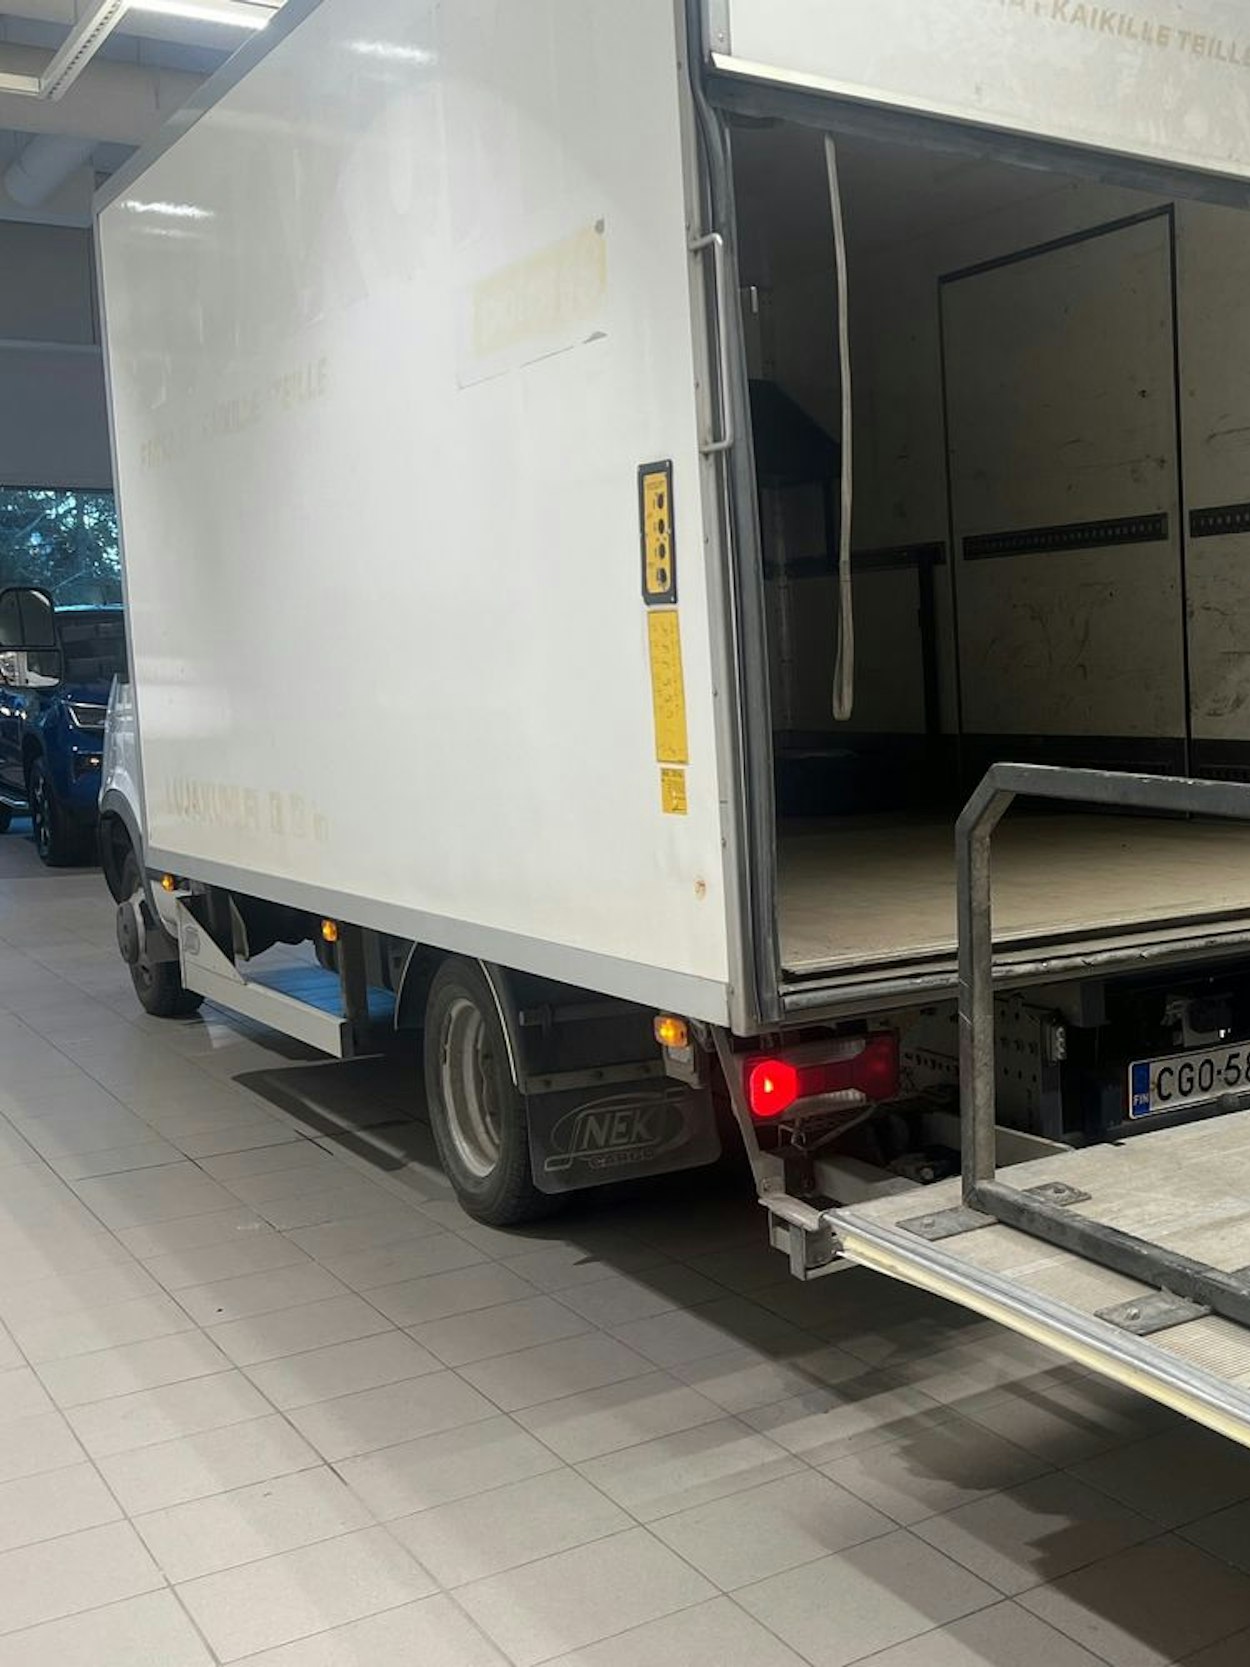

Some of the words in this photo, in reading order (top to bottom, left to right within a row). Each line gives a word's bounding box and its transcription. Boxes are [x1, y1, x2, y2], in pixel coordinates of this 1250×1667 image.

[1052, 0, 1170, 48] KAIKILLE
[1133, 1093, 1150, 1107] FIN
[581, 1106, 655, 1151] NEK
